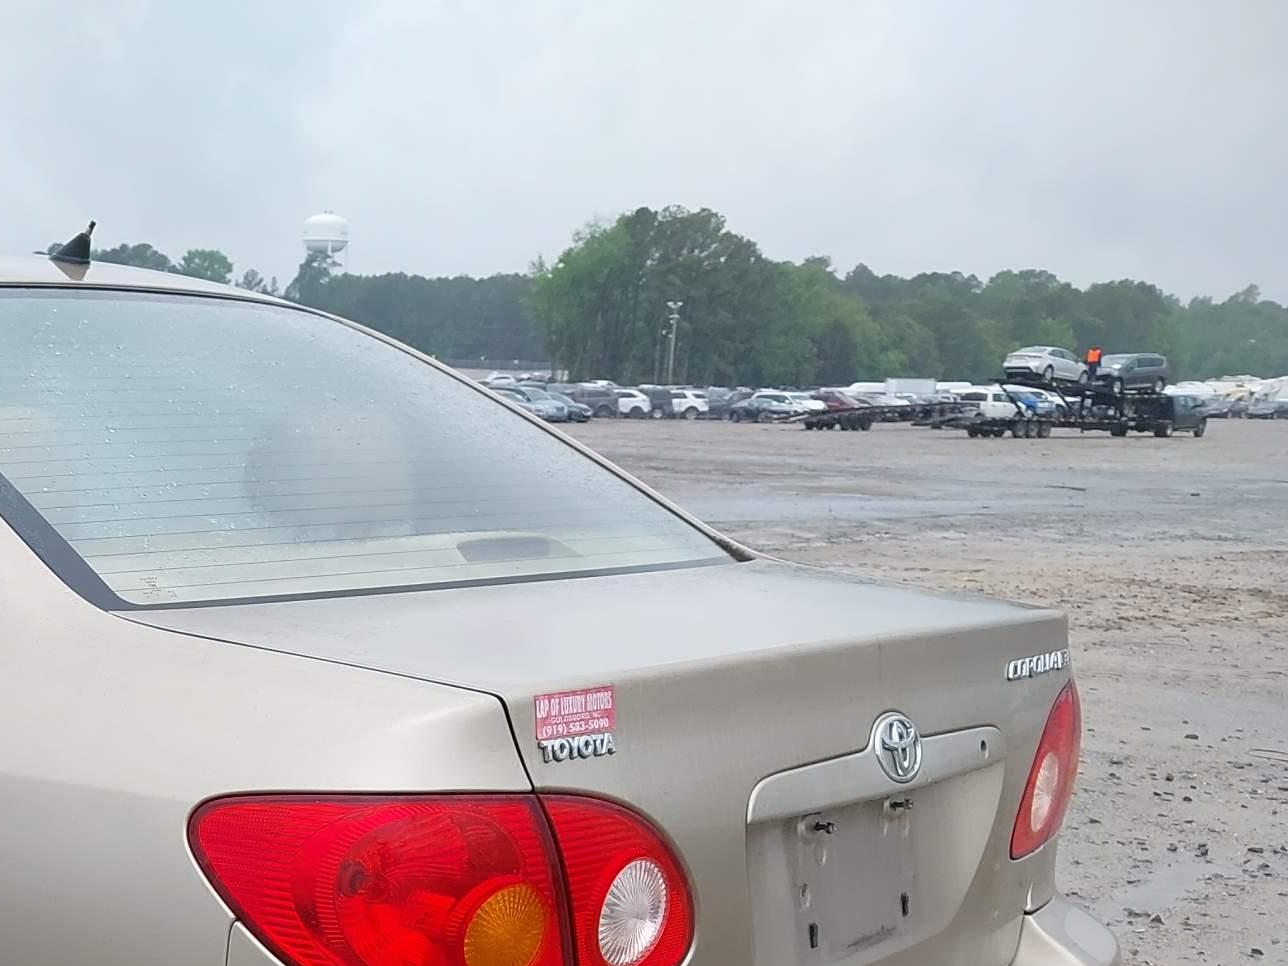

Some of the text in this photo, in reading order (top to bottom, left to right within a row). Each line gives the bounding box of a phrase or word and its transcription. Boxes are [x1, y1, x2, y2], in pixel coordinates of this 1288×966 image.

[536, 691, 612, 718] LAP OF LUXURY MOTORS
[542, 723, 567, 736] (919)
[538, 732, 616, 763] TOYOTA
